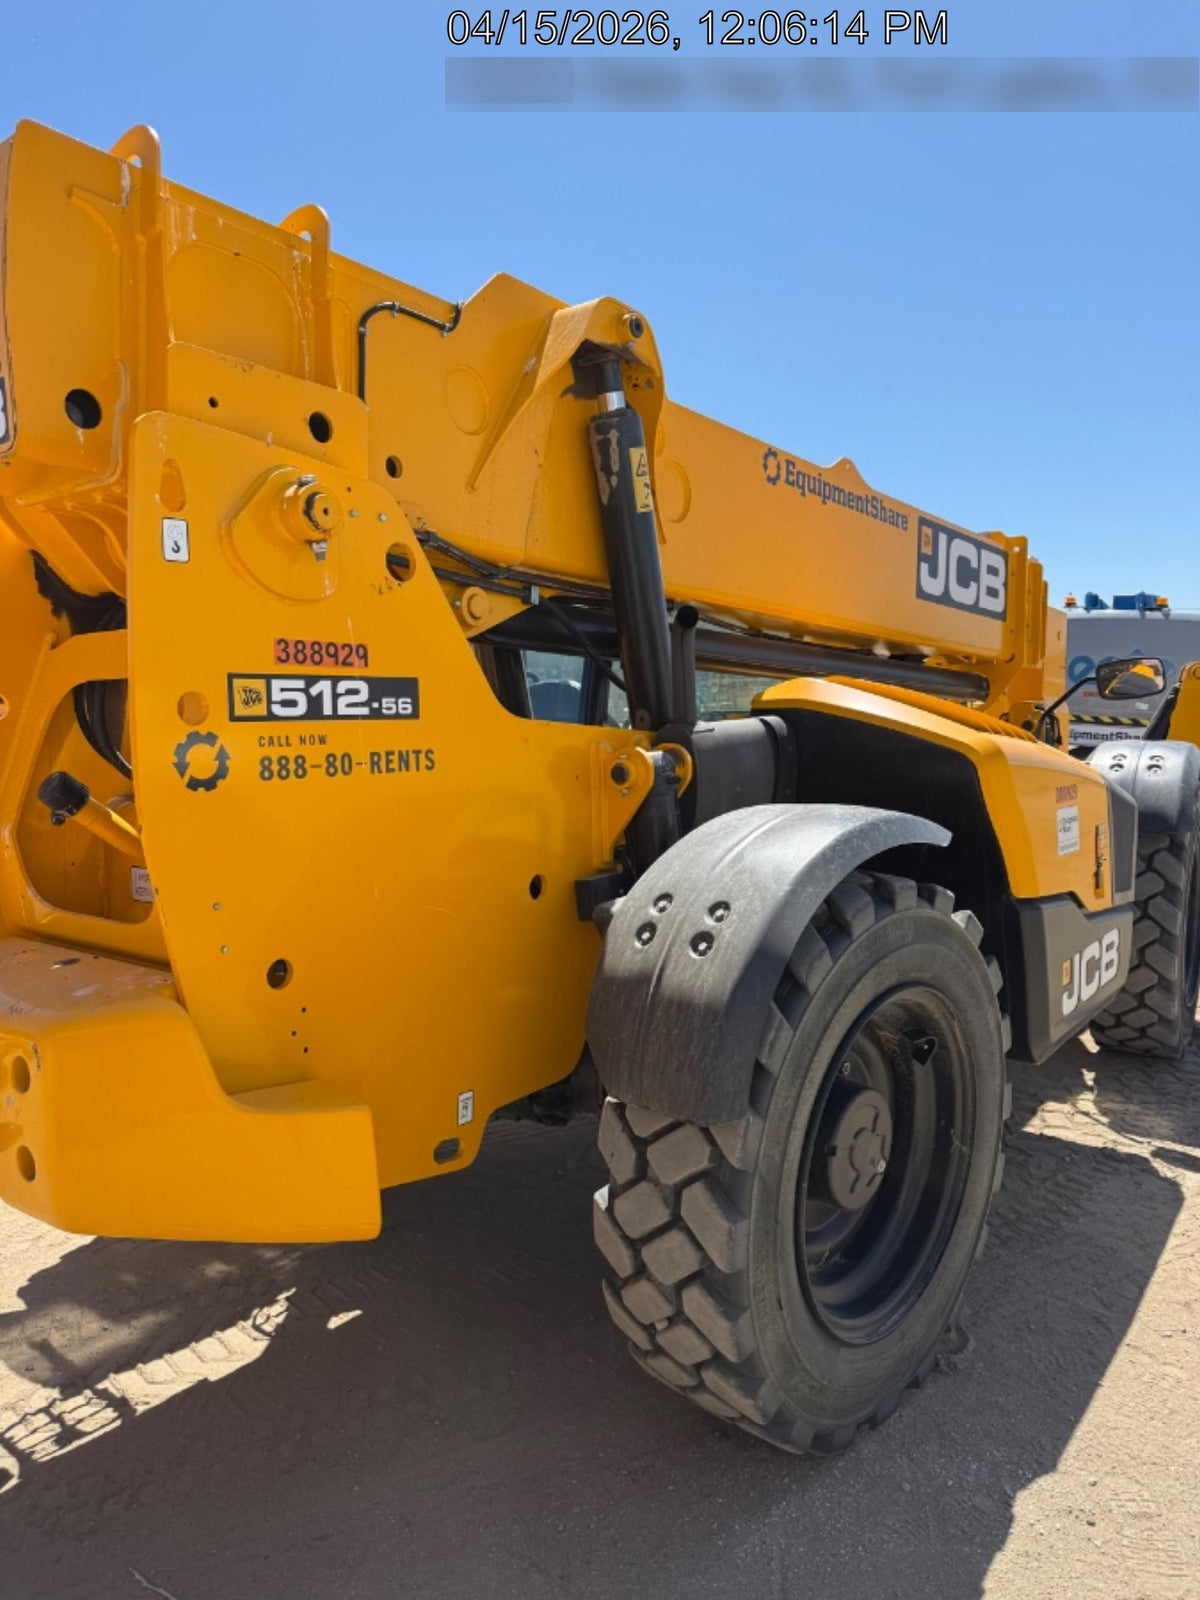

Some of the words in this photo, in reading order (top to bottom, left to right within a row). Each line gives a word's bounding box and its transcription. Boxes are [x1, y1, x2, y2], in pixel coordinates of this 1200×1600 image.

[784, 458, 909, 531] EquipmentShare
[919, 531, 1006, 613] JCB
[276, 638, 368, 667] 388929
[258, 735, 292, 748] CALL
[299, 734, 328, 746] NOW
[259, 749, 435, 781] 888-80-RENTS
[1062, 928, 1119, 1016] JCB
